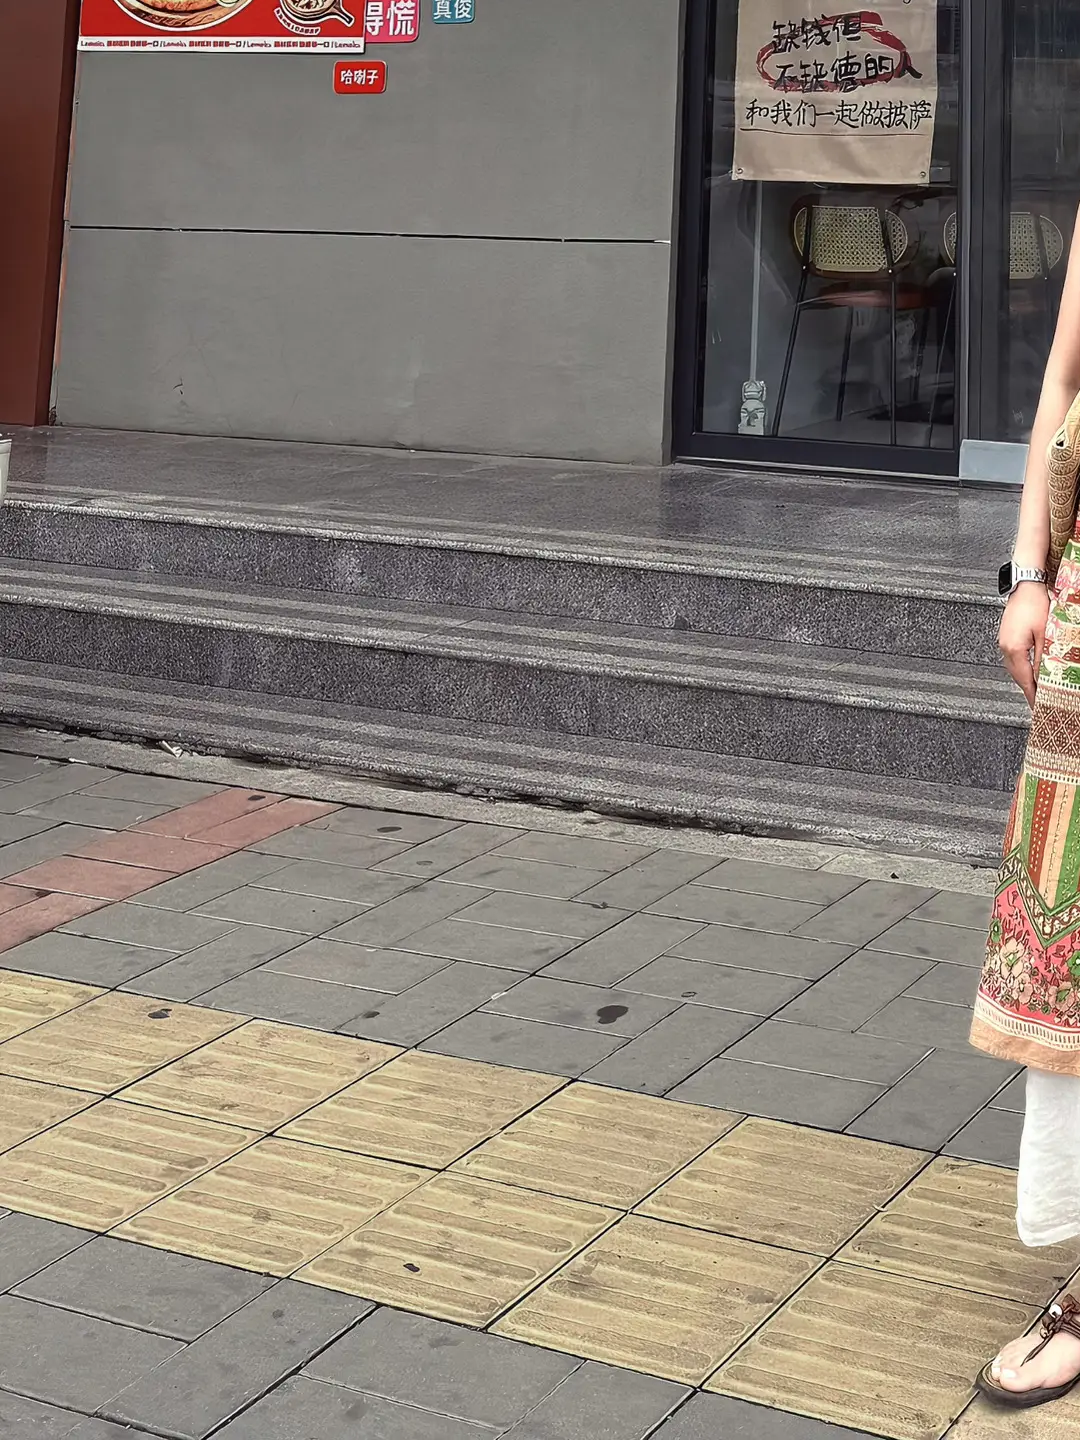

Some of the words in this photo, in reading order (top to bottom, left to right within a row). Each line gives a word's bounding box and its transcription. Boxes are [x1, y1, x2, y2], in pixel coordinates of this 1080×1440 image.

[772, 14, 861, 53] 缺钱但
[773, 50, 923, 93] 不缺德的人
[745, 98, 933, 130] 和我们一起做披萨
